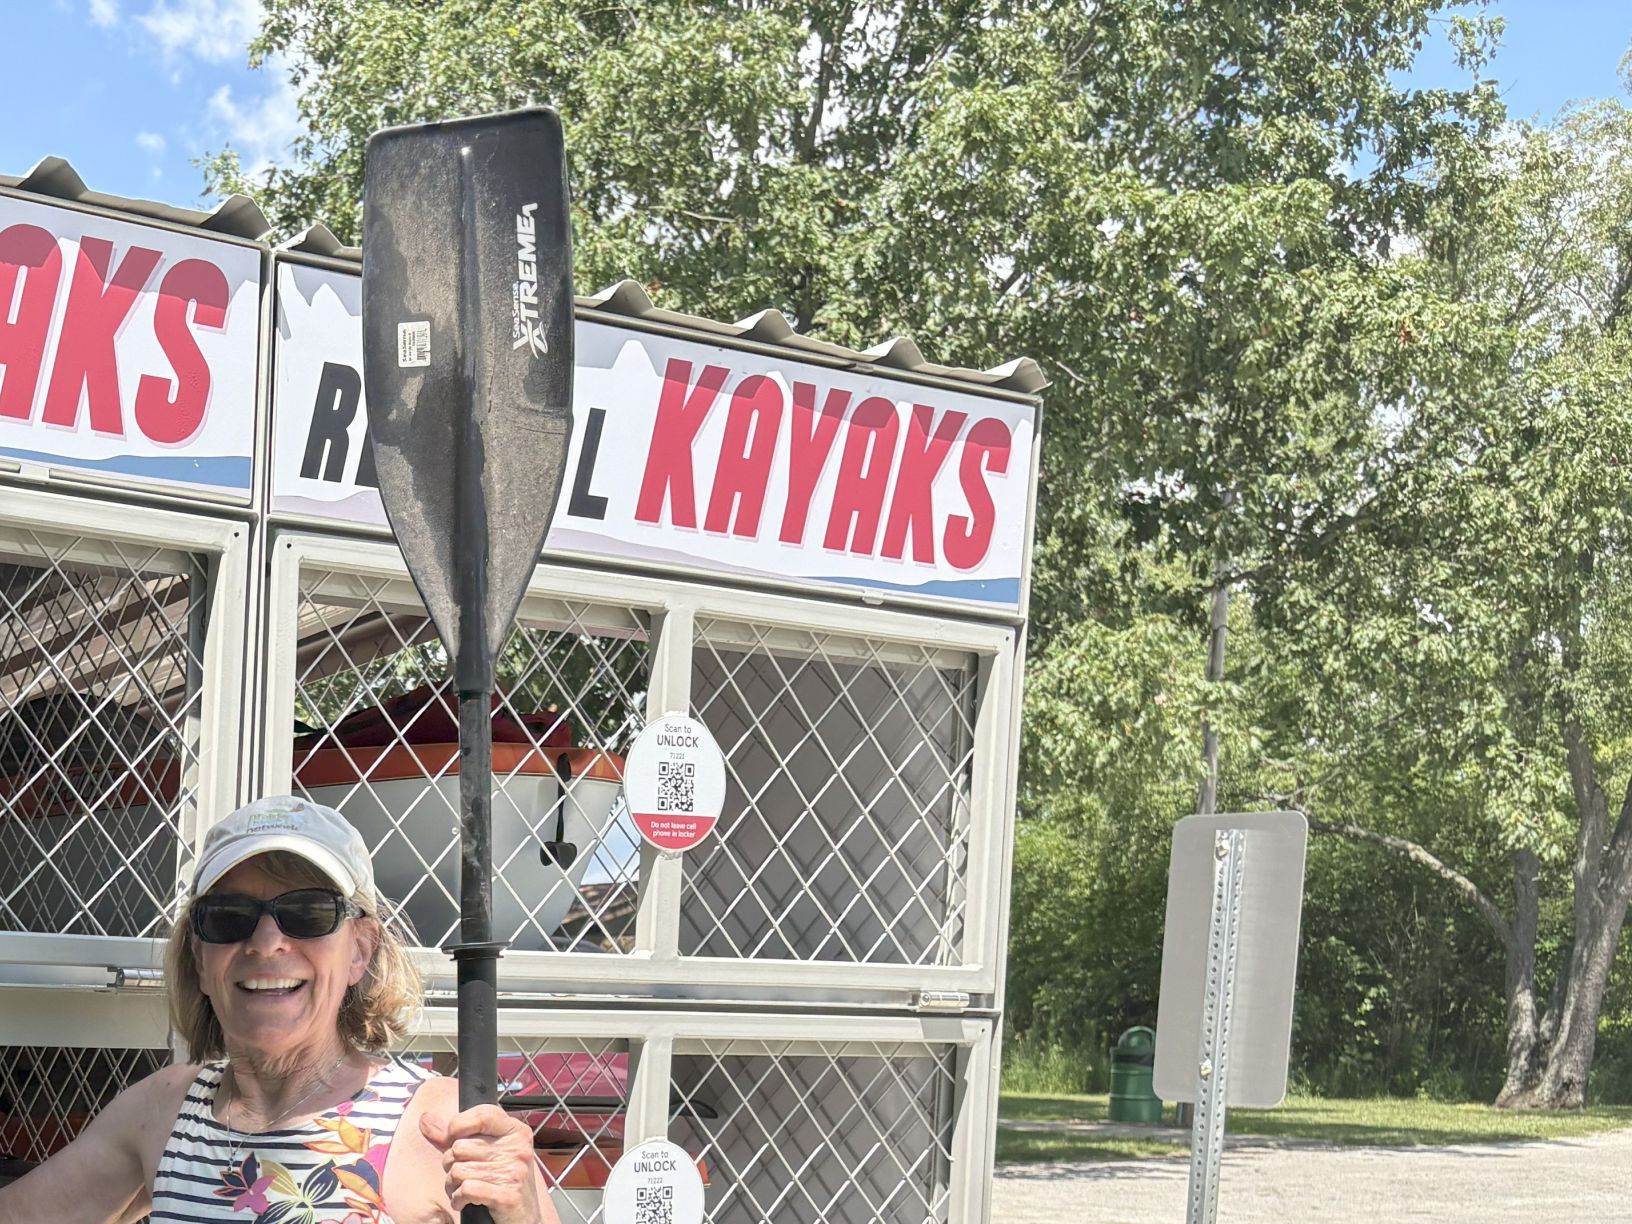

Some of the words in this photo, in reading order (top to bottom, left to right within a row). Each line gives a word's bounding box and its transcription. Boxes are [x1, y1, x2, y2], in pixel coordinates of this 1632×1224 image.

[633, 357, 1012, 570] KAYAKS
[665, 724, 682, 733] Scan
[684, 725, 692, 734] to
[657, 735, 698, 748] UNLOCK
[653, 830, 670, 838] phone
[642, 1151, 659, 1159] Scan
[661, 1150, 668, 1158] to
[634, 1160, 676, 1173] UNLOCK
